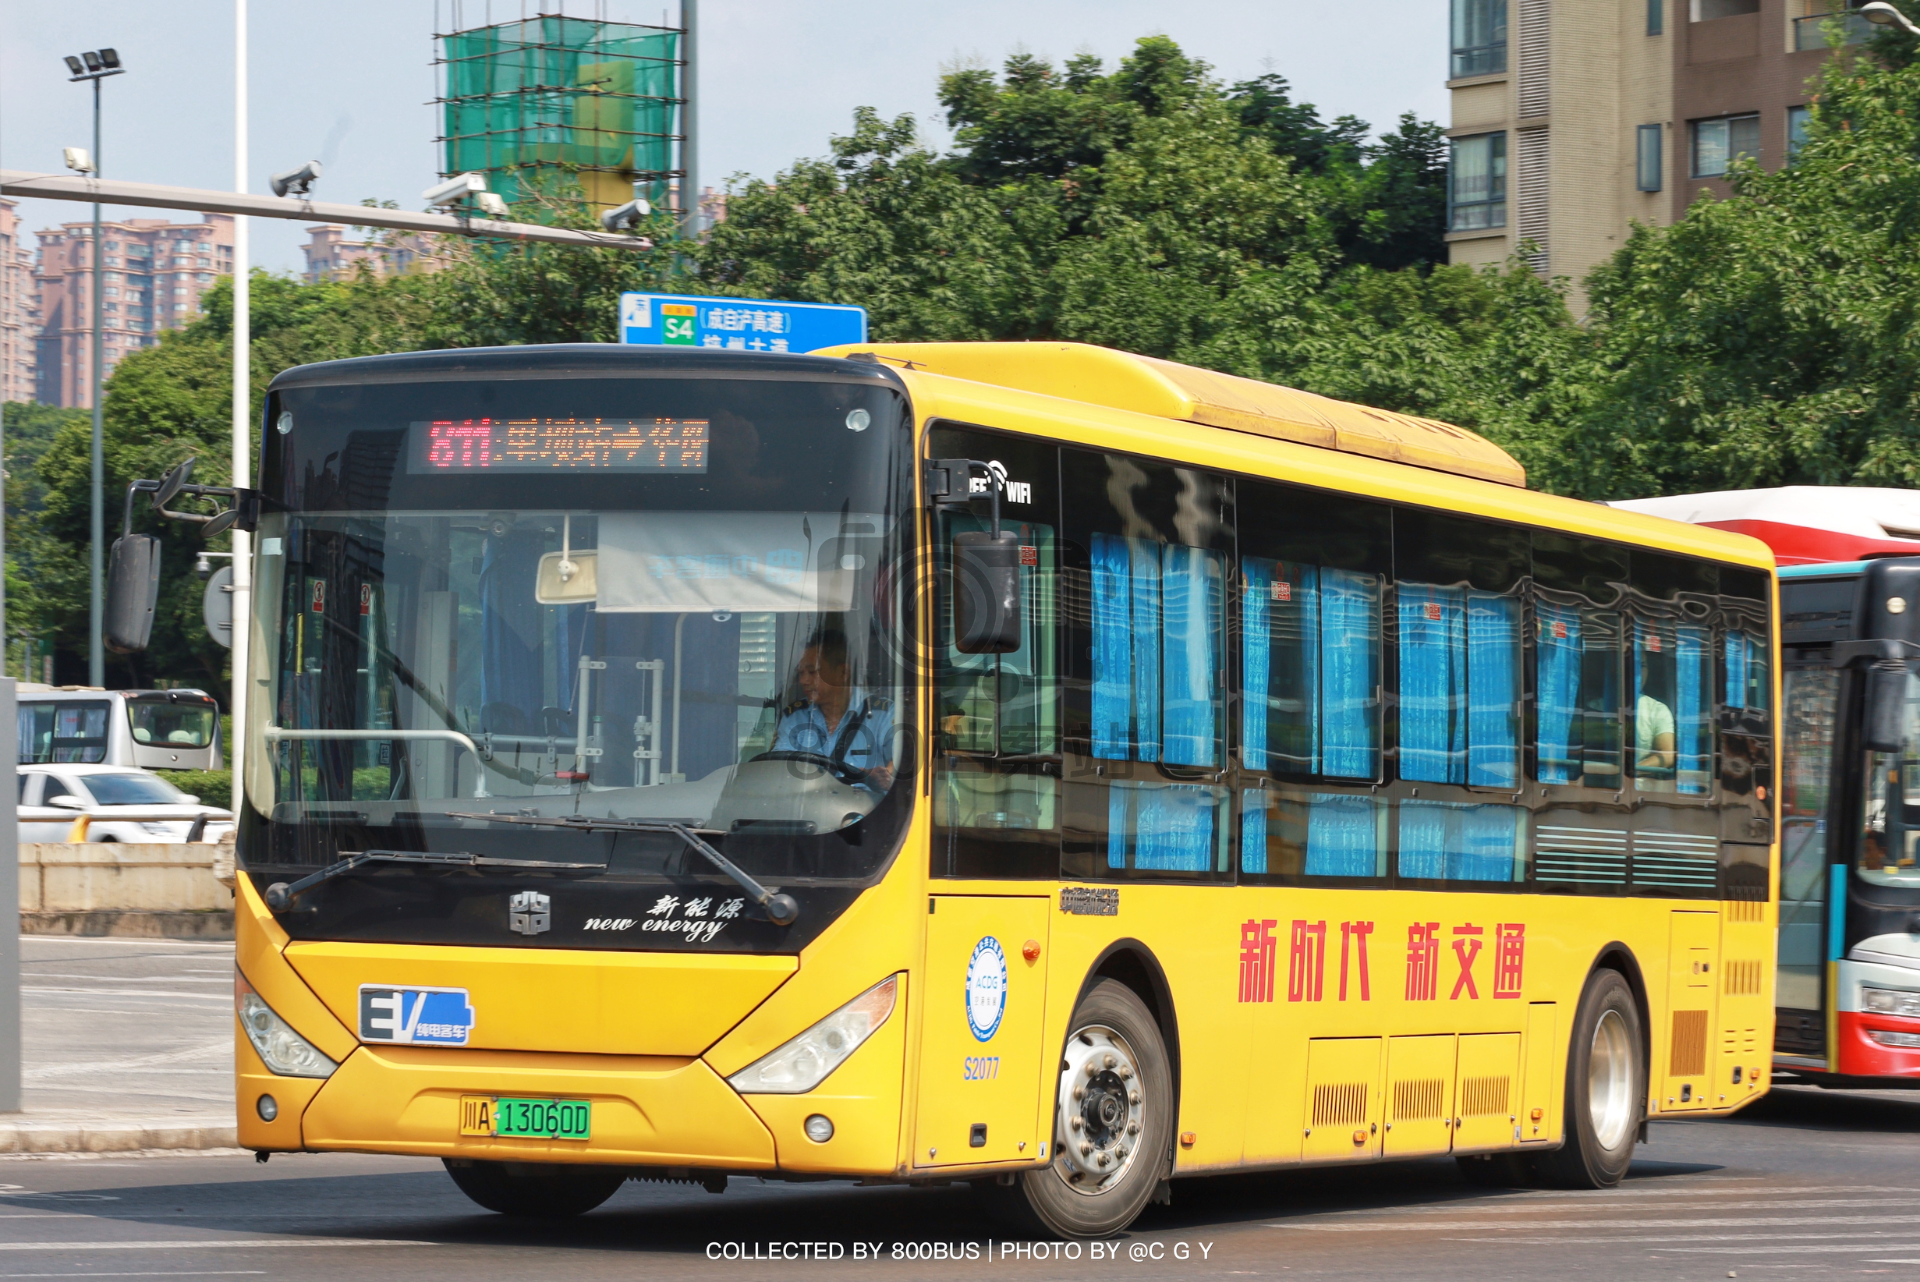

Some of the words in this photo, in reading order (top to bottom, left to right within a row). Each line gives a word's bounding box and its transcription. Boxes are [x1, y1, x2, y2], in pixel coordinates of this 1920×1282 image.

[664, 317, 695, 340] S4
[1005, 480, 1032, 504] WIFI
[646, 894, 745, 919] 新能源
[583, 917, 638, 931] new
[641, 917, 729, 943] energy
[1238, 919, 1374, 1003] 新时代
[1405, 922, 1525, 1001] 新交通
[975, 974, 998, 990] ACDG
[963, 1056, 1000, 1081] S2077
